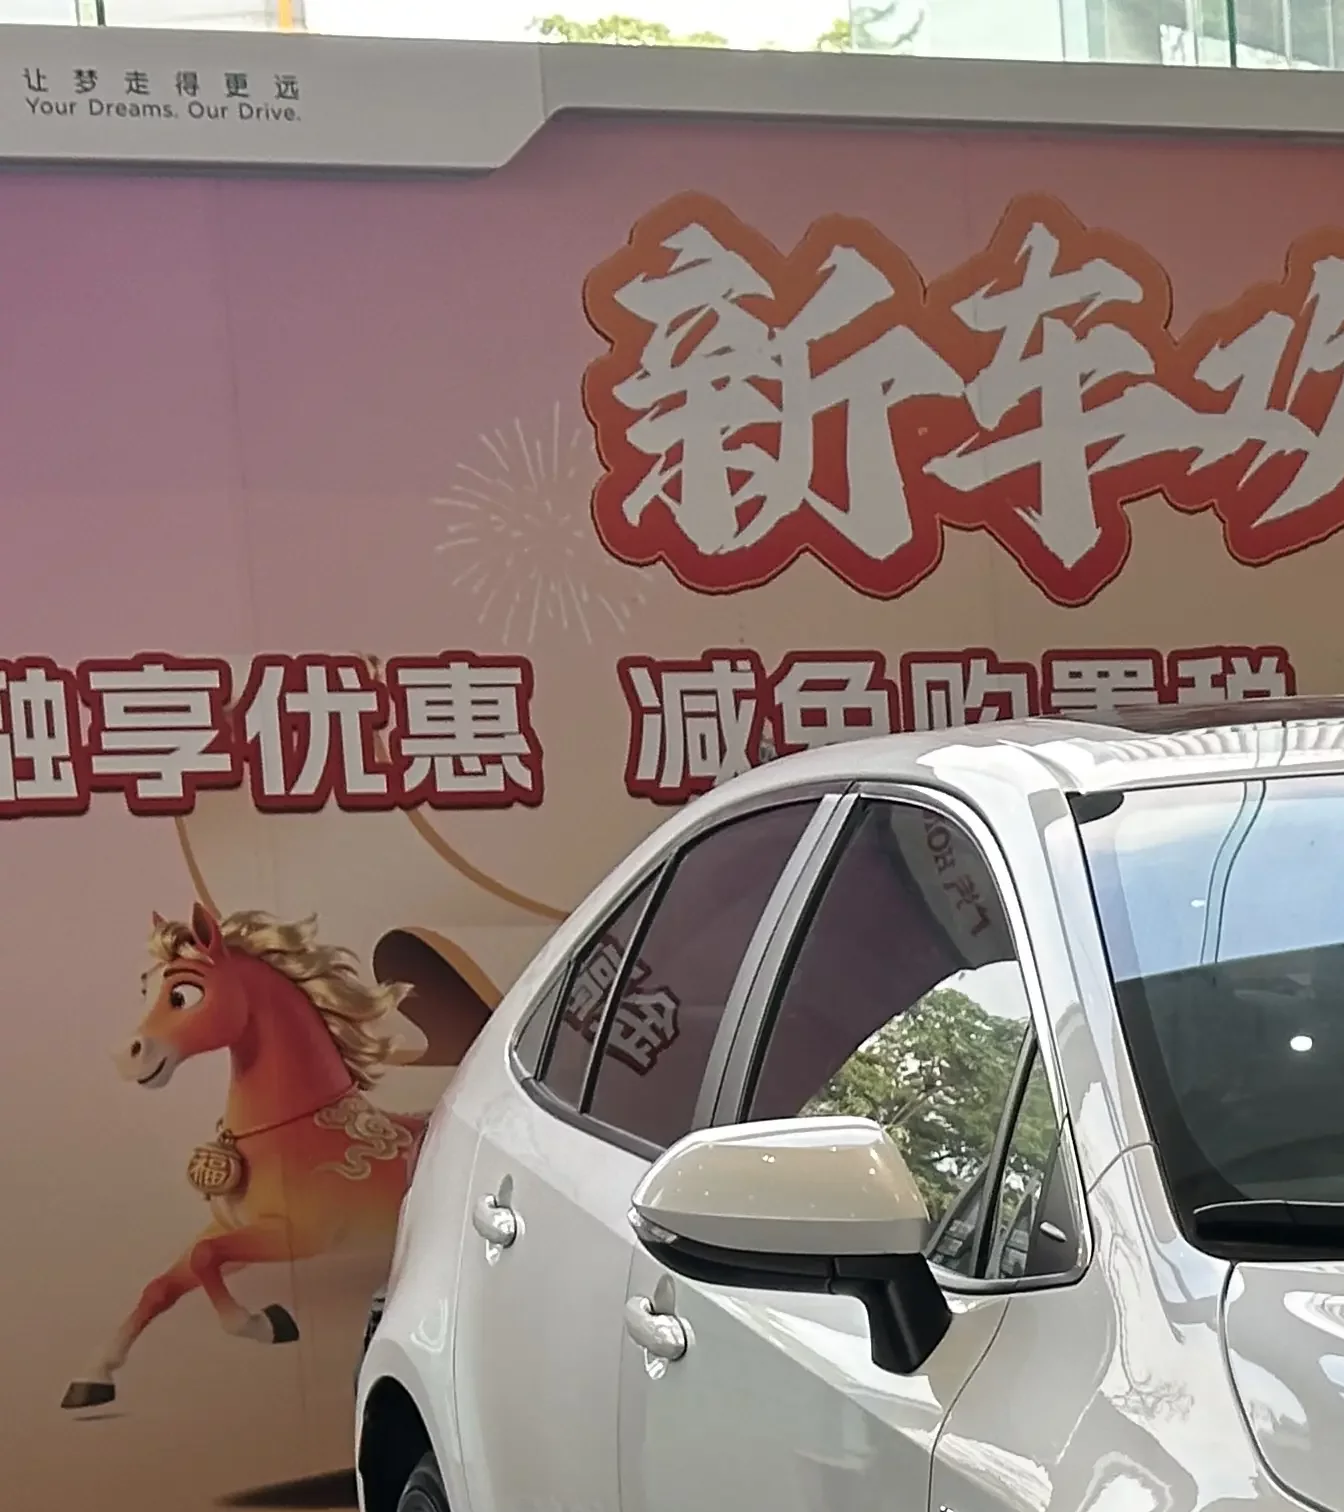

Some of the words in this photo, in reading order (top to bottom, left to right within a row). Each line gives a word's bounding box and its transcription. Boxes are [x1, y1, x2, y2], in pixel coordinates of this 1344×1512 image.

[22, 67, 300, 101] 让梦走得更远
[25, 97, 77, 117] Your
[88, 98, 178, 120] Dreams.
[187, 100, 229, 121] Our
[238, 102, 302, 122] Drive.
